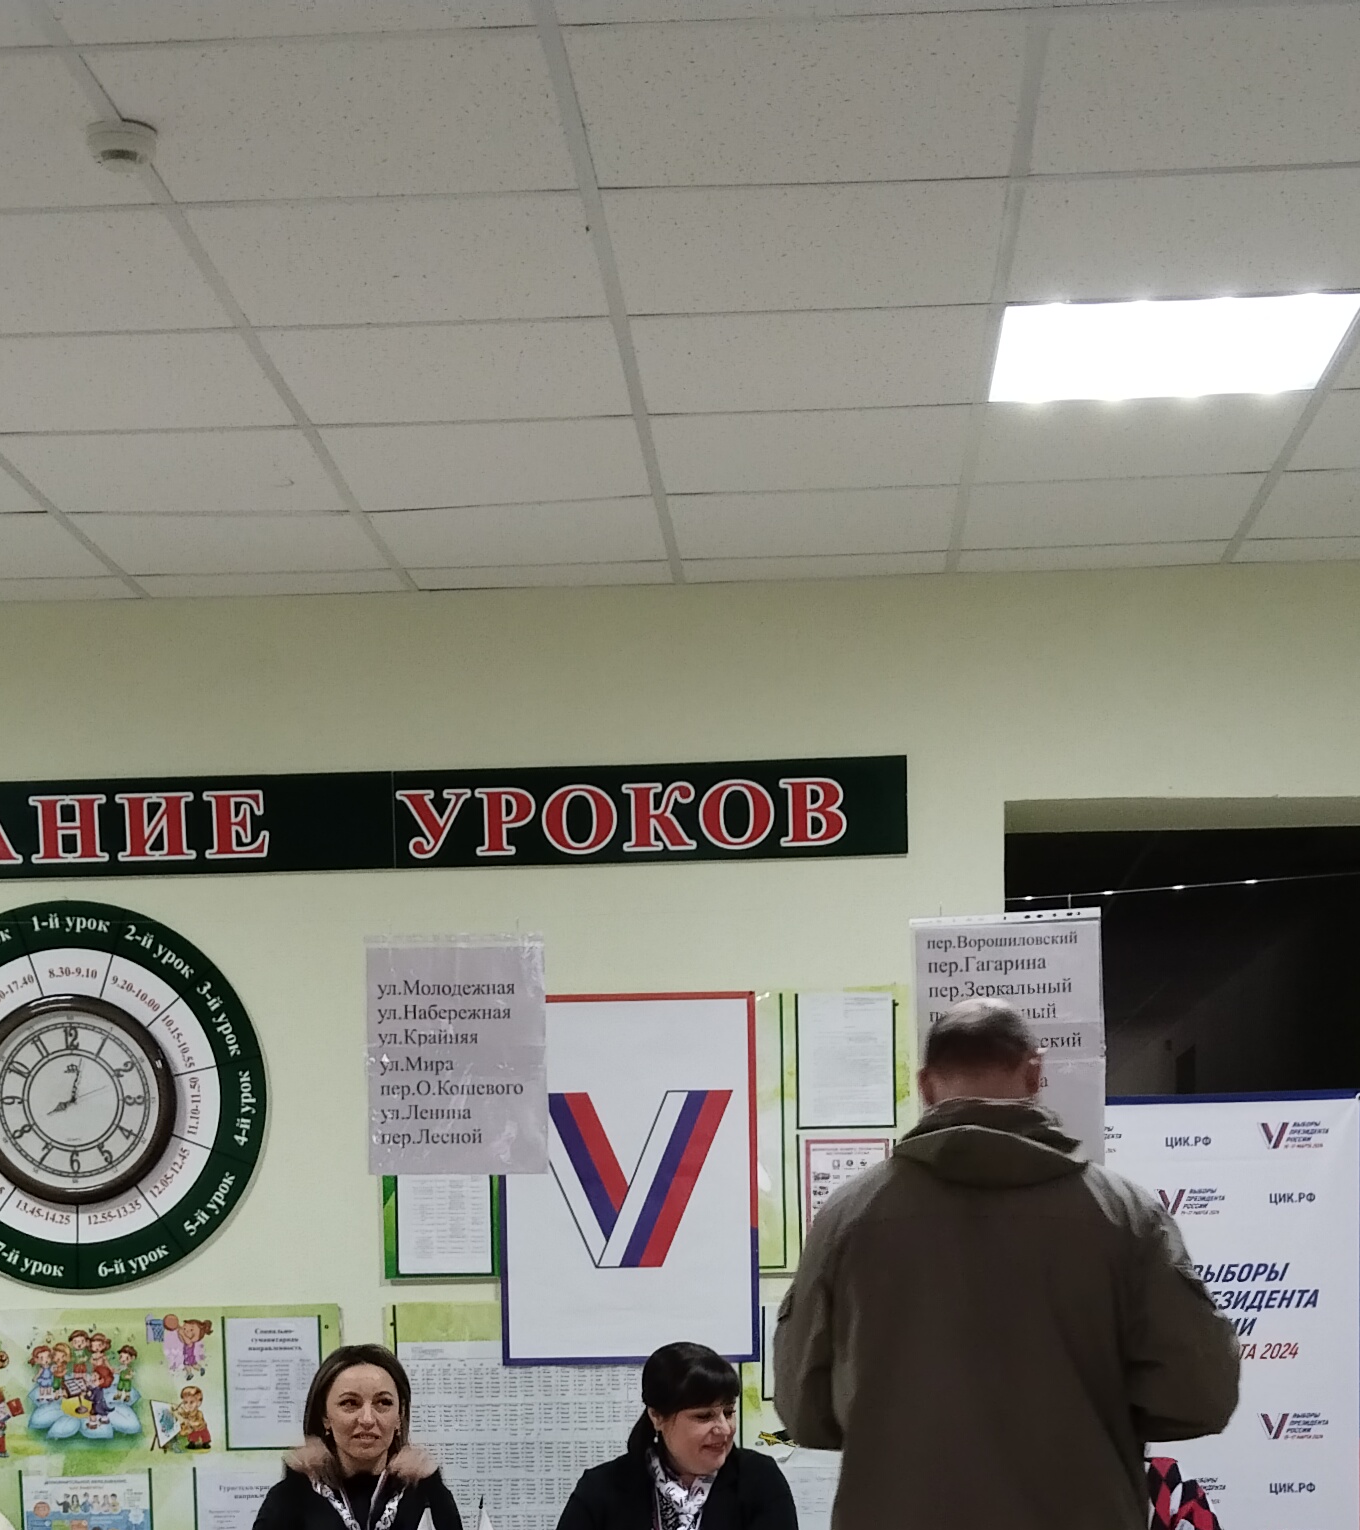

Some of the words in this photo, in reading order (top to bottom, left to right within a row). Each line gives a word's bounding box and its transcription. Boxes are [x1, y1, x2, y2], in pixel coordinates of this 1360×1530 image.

[395, 776, 849, 859] УРОКОВ
[31, 913, 60, 933] 1-й
[65, 915, 111, 933] урок
[124, 925, 154, 950] 2-й
[153, 944, 196, 979] урок
[927, 931, 1078, 952] пер.Ворошиловский
[48, 966, 98, 980] 8.30-9.10
[928, 955, 1047, 977] пер.Гагарина
[110, 975, 162, 1013] 9.20-10.00
[377, 979, 515, 999] ул.Молодежная
[929, 978, 1073, 1001] пер.Зеркальный
[196, 981, 224, 1012] 3-й
[212, 1013, 241, 1058] урок
[377, 1004, 511, 1024] ул.Набережная
[161, 1014, 196, 1069] 10.15-10.55
[378, 1028, 479, 1048] ул.Крайняя
[380, 1056, 454, 1076] ул.Мира
[239, 1070, 257, 1115] урок
[380, 1080, 524, 1100] пер.О.Кошевого
[187, 1076, 201, 1136] 11.10-11.50
[380, 1104, 472, 1125] ул.Ленина
[233, 1119, 252, 1147] 4-й
[380, 1128, 483, 1149] пер.Лесной
[1165, 1135, 1212, 1149] ЦИК.РФ
[148, 1146, 190, 1199] 12.05-12.45
[183, 1209, 211, 1237] 5-й
[206, 1171, 236, 1215] урок
[1269, 1192, 1316, 1206] ЦИК.РФ
[15, 1199, 71, 1226] 13.45-14.25
[87, 1199, 143, 1226] 12.55-13.35
[20, 1257, 65, 1278] урок
[97, 1259, 126, 1278] 6-й
[128, 1244, 170, 1275] урок
[1193, 1262, 1290, 1283] ВЫБОРЫ
[1211, 1289, 1320, 1312] ЕЗИДЕНТА
[1259, 1342, 1300, 1360] 2024
[1269, 1482, 1316, 1495] ЦИК.РФ
